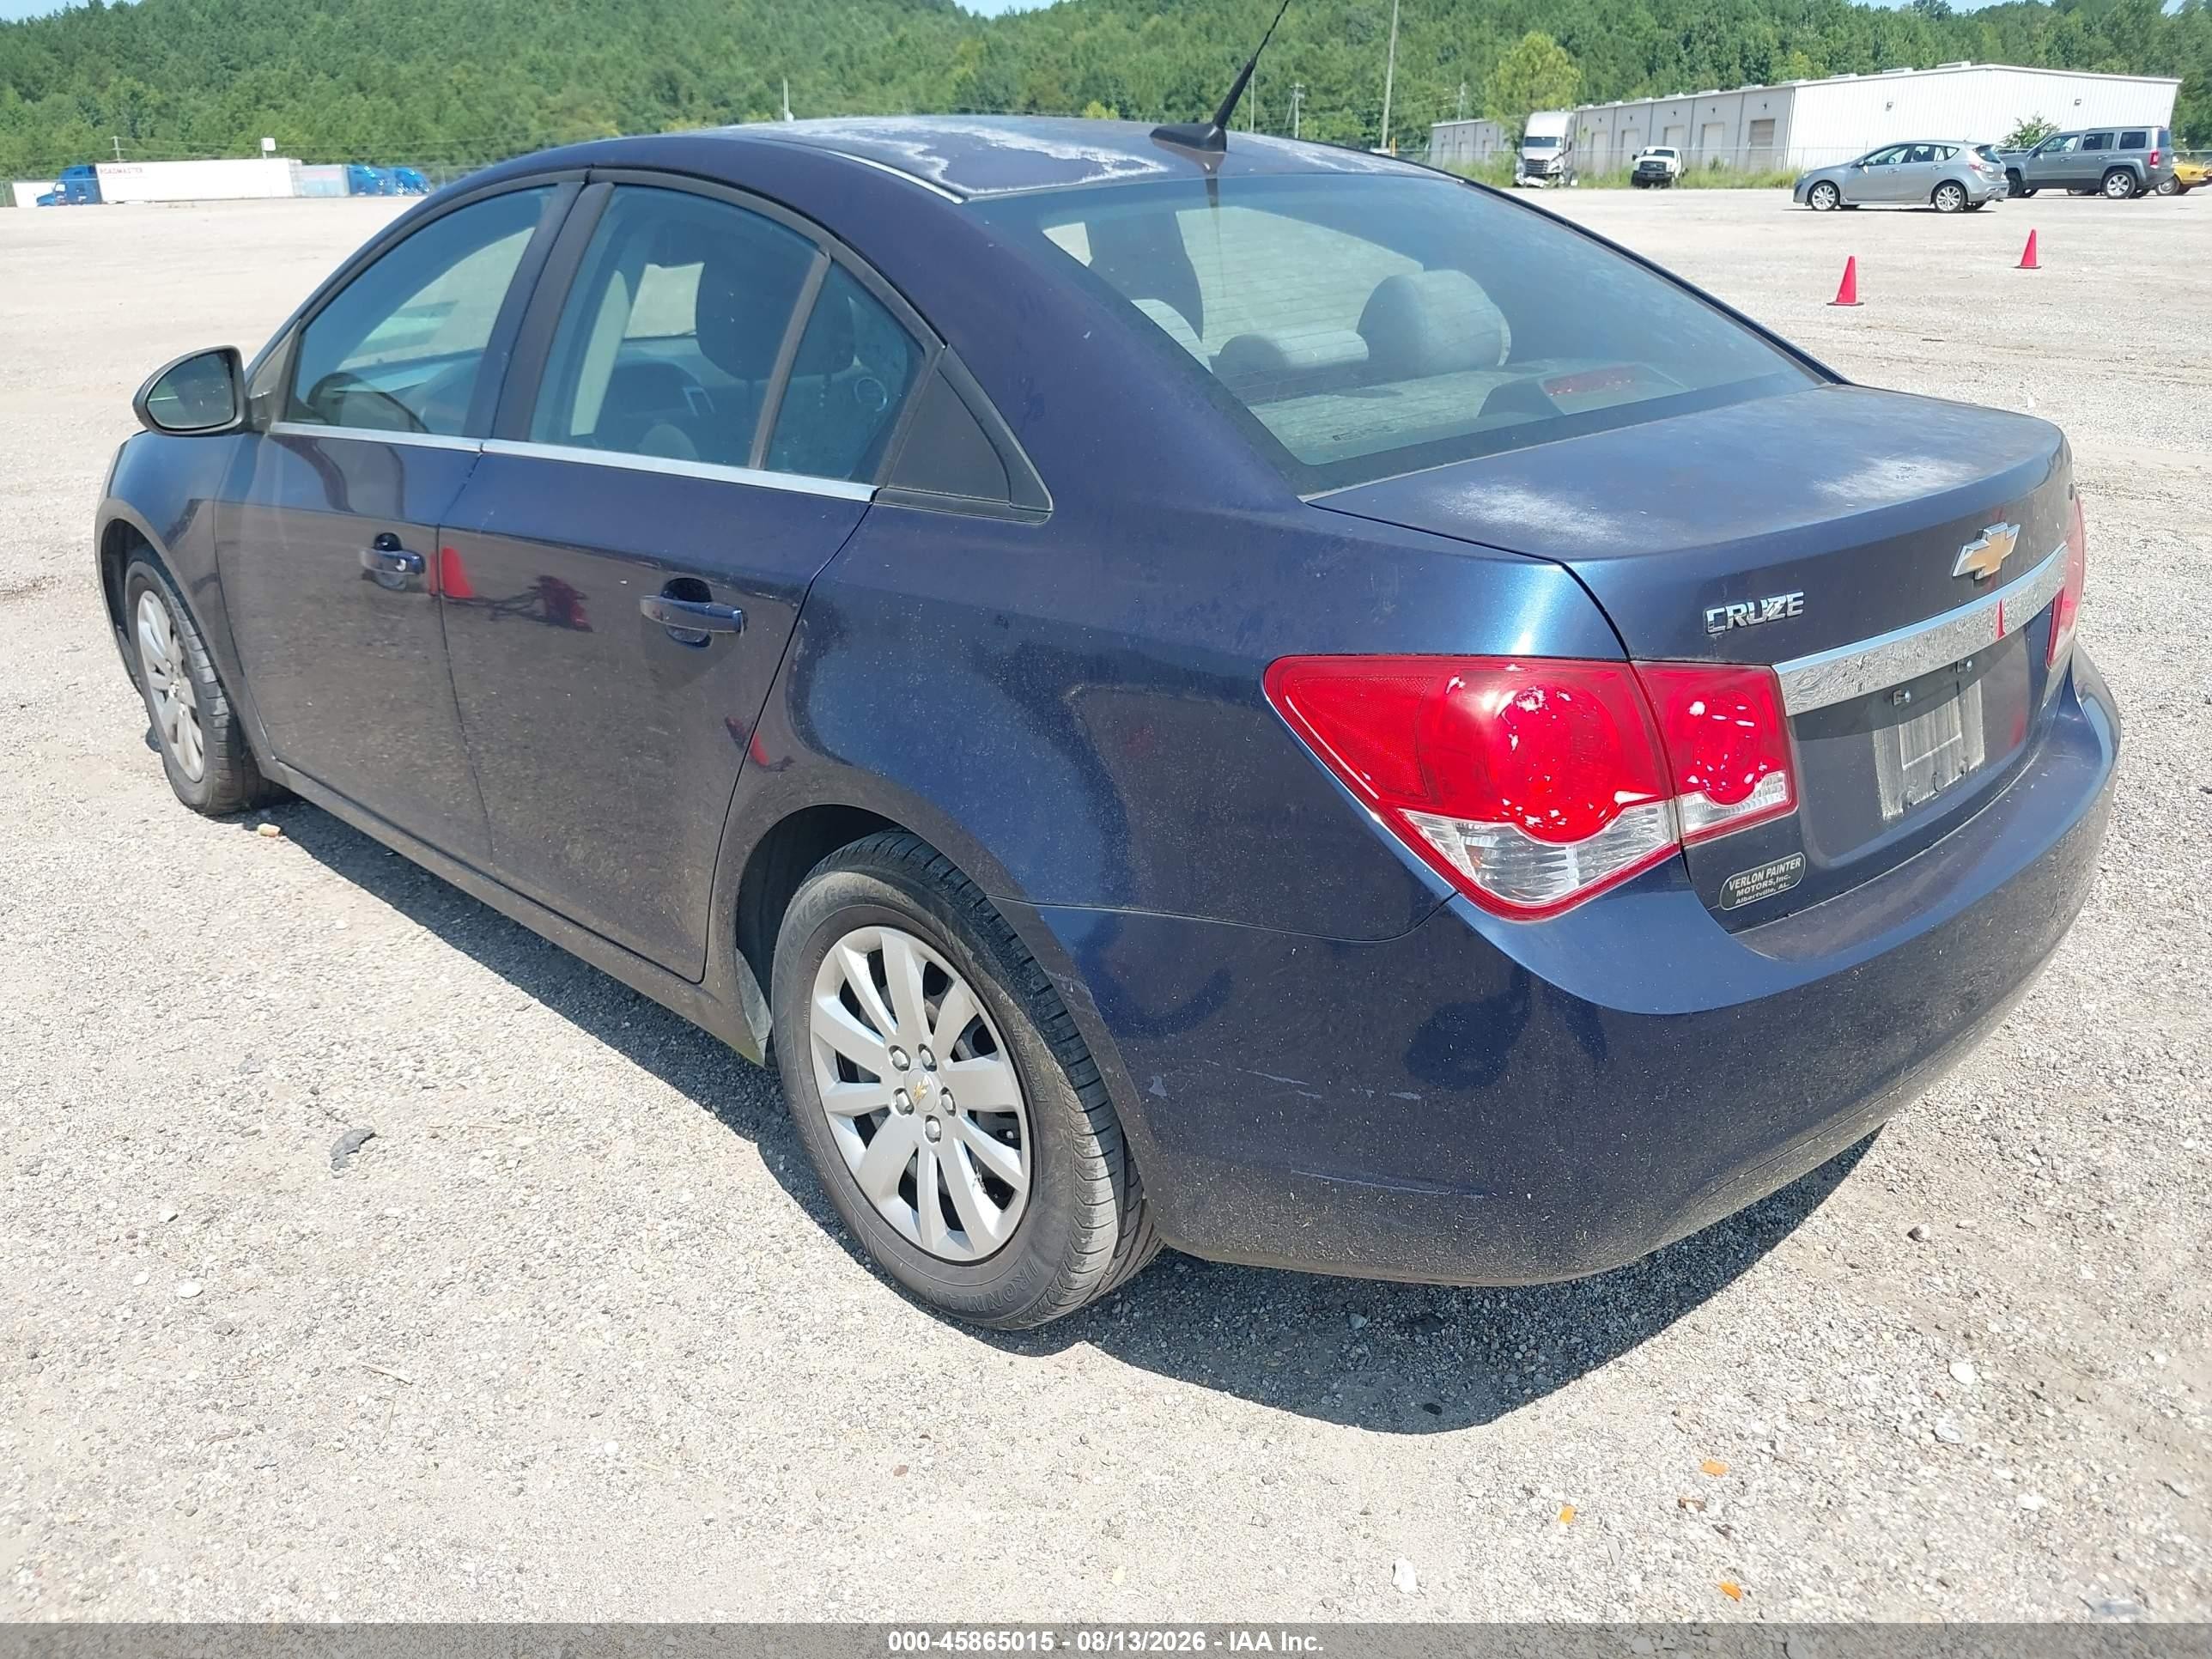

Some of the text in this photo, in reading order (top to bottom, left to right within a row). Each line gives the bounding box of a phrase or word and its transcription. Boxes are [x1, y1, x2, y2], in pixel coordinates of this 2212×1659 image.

[1705, 591, 1804, 634] CRUZE
[1729, 857, 1802, 891] VERLON PAINTER
